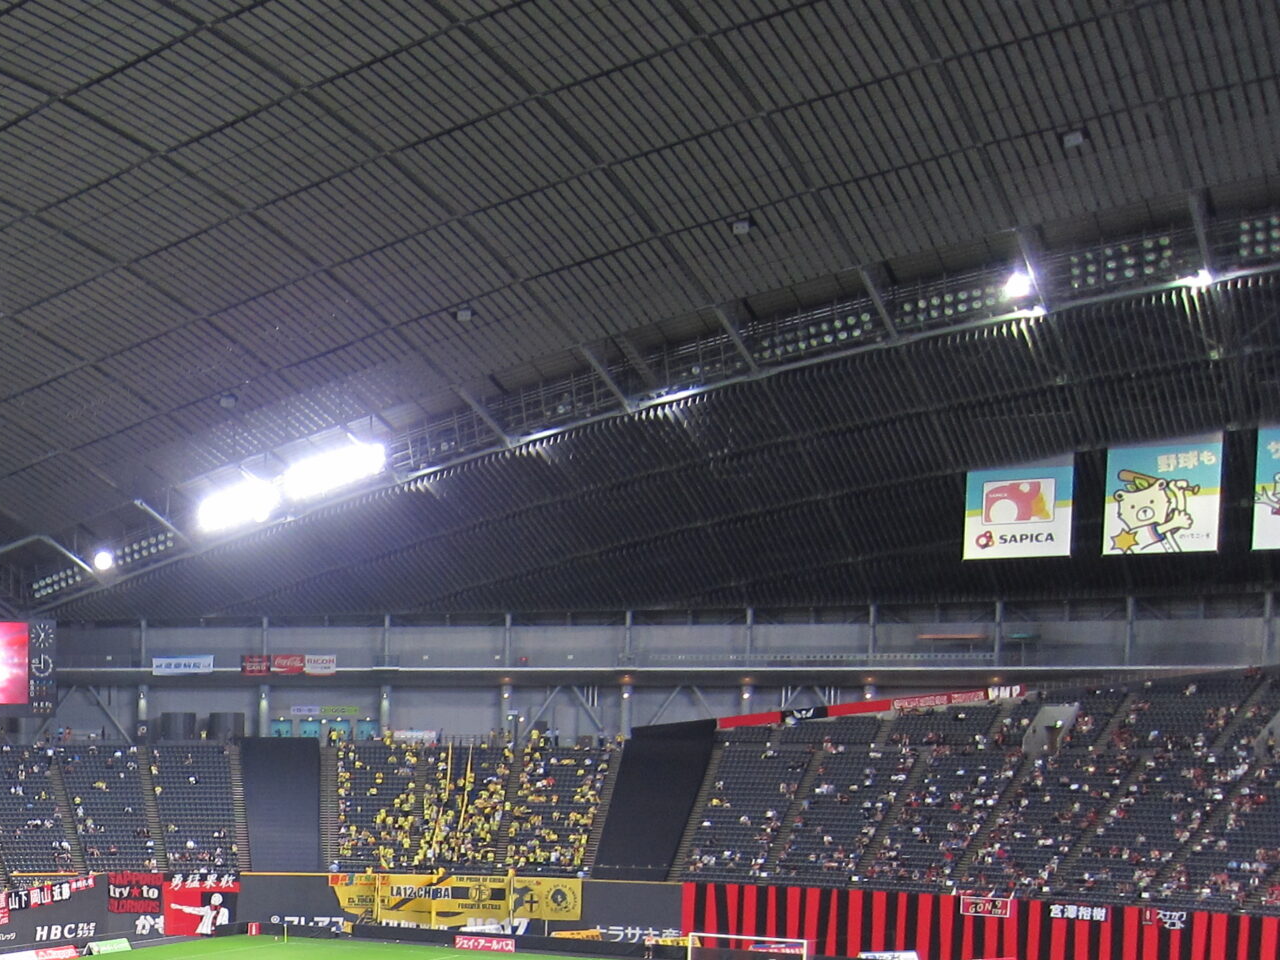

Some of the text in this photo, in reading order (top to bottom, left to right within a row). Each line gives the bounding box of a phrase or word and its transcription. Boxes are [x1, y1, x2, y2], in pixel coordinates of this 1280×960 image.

[1157, 451, 1217, 473] 野球も
[998, 533, 1055, 545] SAPICA
[109, 885, 159, 899] try to
[416, 886, 451, 899] CHBA
[8, 890, 28, 909] 山下
[969, 902, 993, 913] GON
[35, 923, 76, 941] HBC
